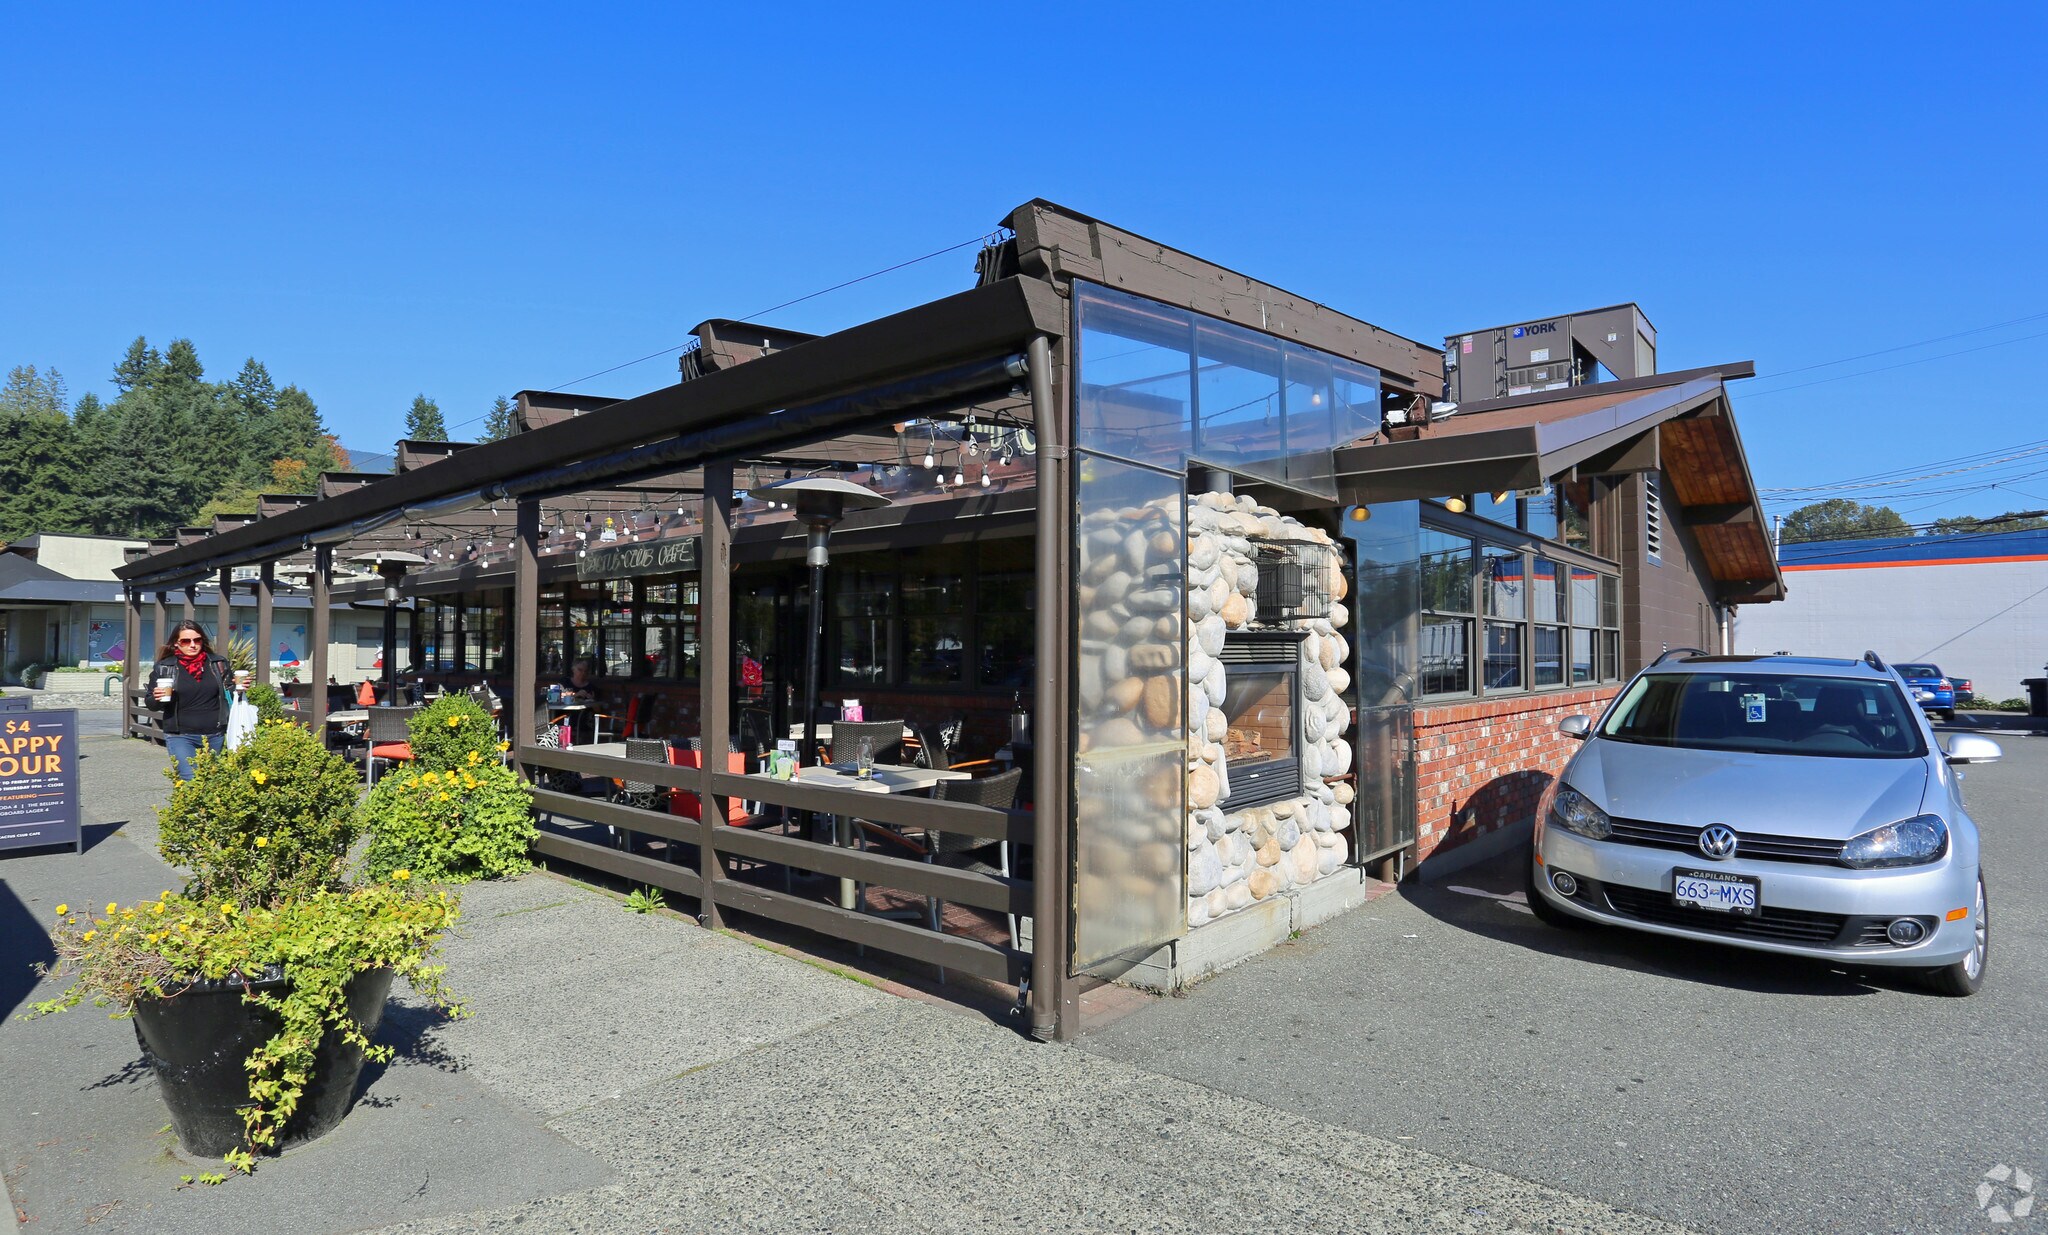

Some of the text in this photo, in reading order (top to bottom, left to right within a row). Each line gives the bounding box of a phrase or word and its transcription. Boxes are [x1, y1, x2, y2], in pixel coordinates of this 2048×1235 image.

[1524, 322, 1557, 337] YORK
[623, 548, 654, 568] CLUB
[5, 720, 31, 735] $4
[0, 754, 63, 777] OUR
[1693, 871, 1738, 882] CAPILANO
[1677, 880, 1755, 906] 663 MXS
